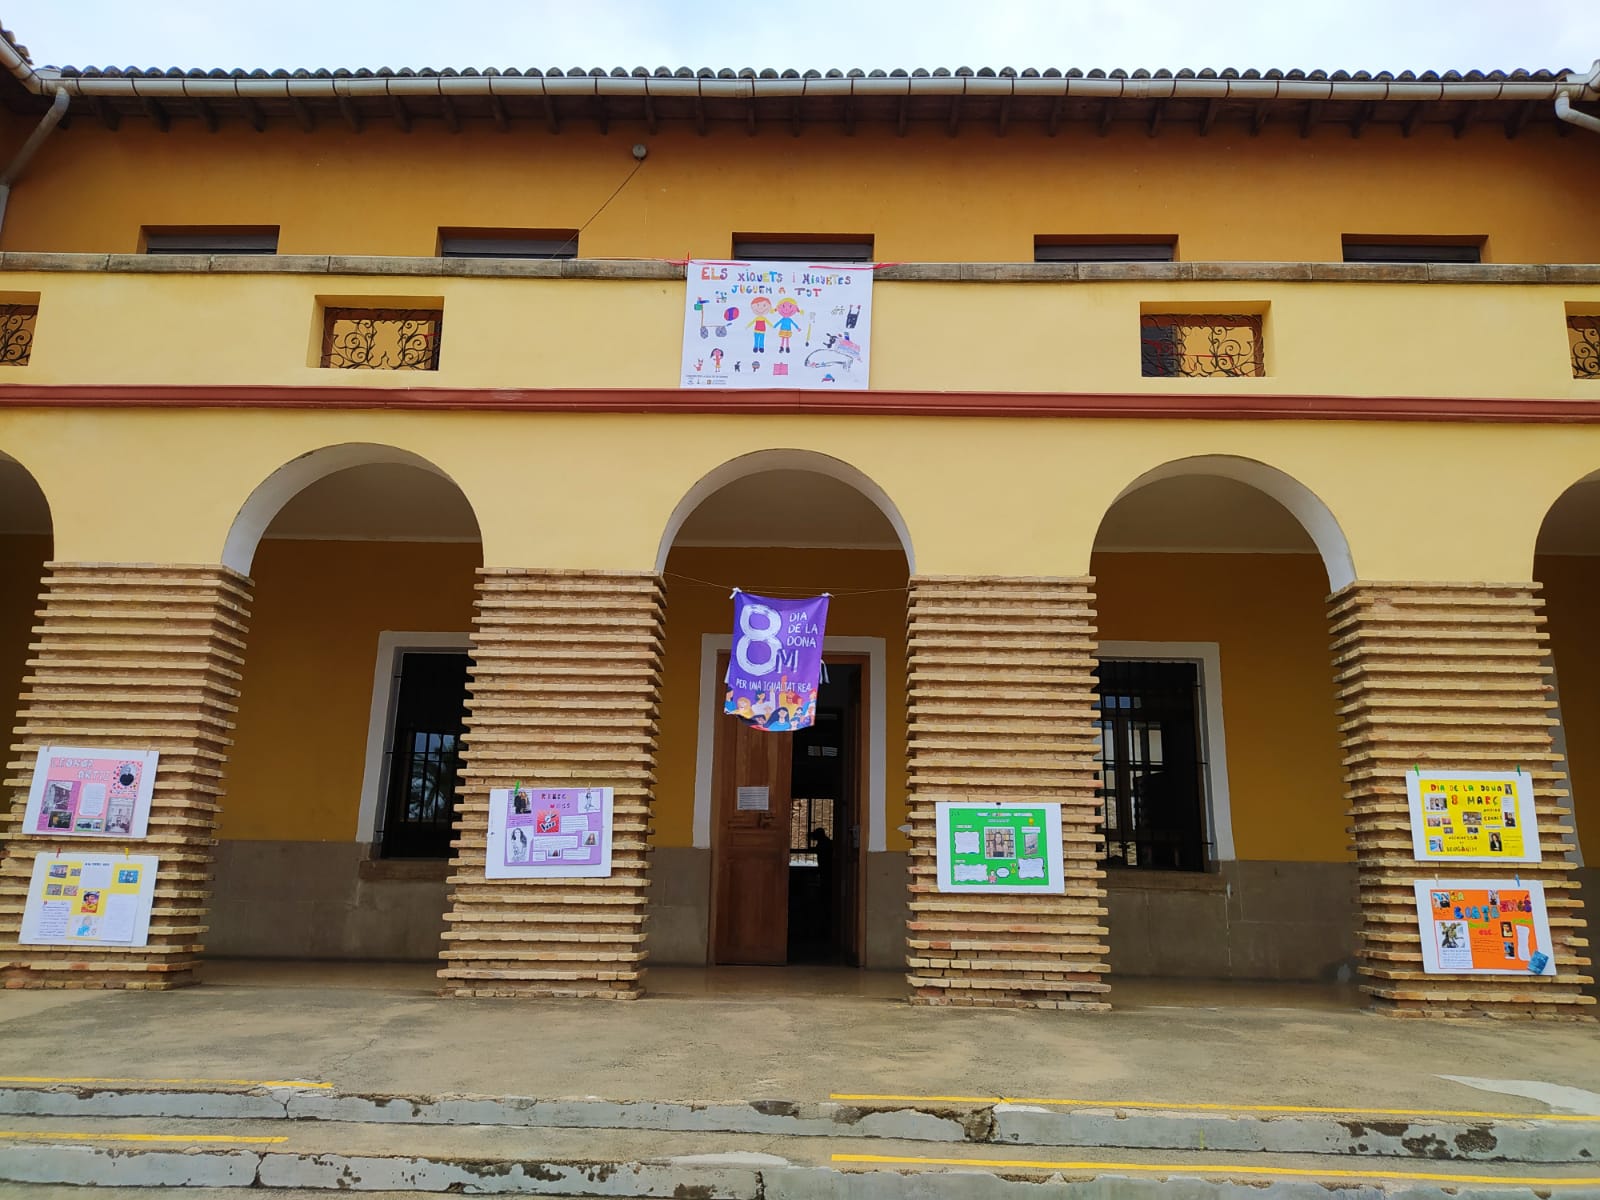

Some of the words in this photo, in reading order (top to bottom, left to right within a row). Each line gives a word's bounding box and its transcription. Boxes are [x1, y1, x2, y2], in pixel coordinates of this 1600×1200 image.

[701, 266, 728, 281] ELS
[794, 287, 822, 297] TOT
[789, 611, 808, 622] DIA
[788, 623, 801, 634] DE
[805, 623, 819, 635] LA
[786, 635, 817, 648] DONA
[736, 677, 748, 689] PER
[749, 680, 762, 691] UNA
[1430, 783, 1445, 792] DIA
[1463, 783, 1475, 792] LA
[1480, 784, 1502, 792] DONA
[1451, 794, 1459, 806] 8
